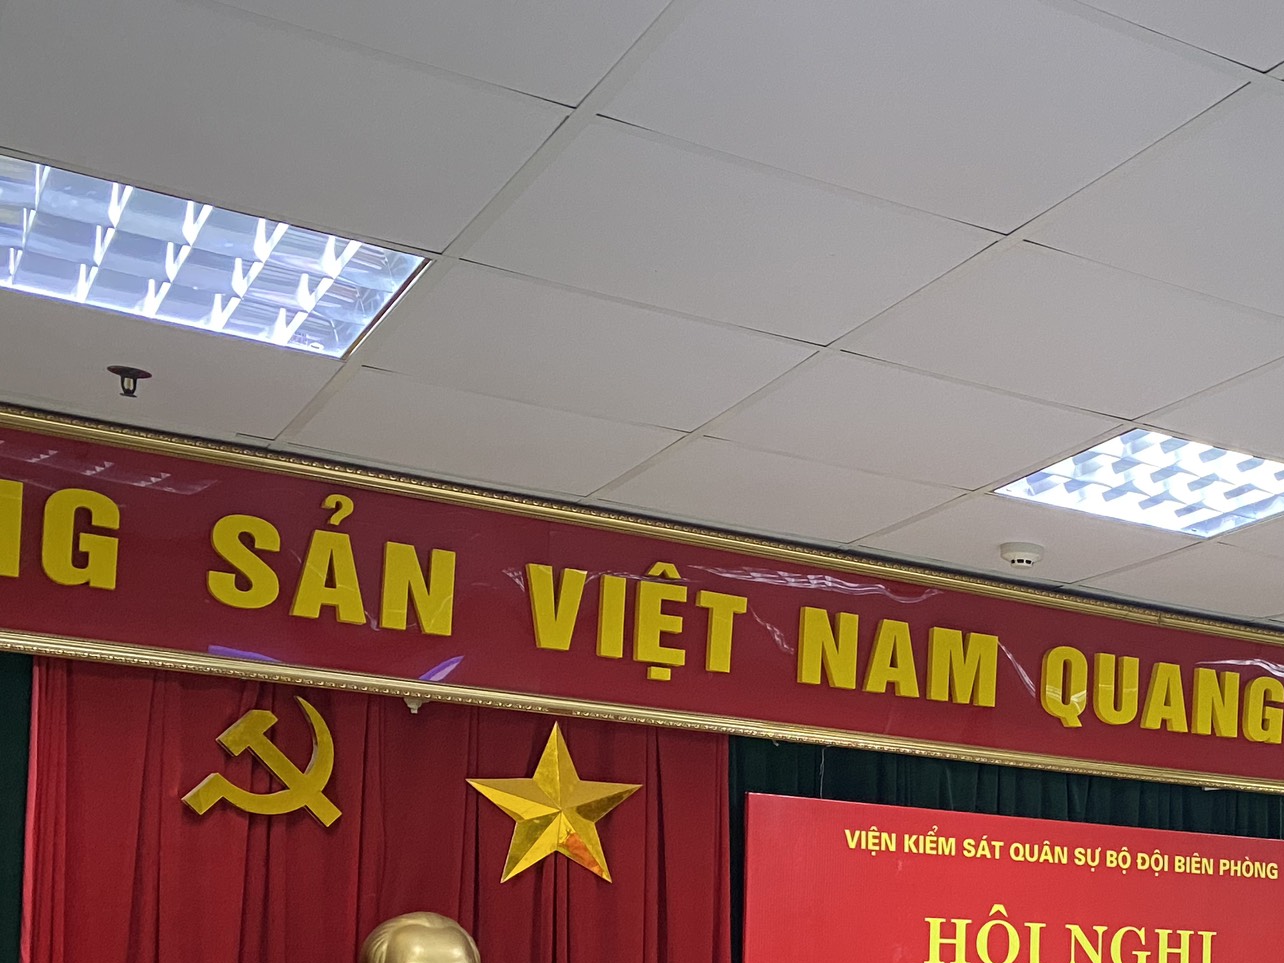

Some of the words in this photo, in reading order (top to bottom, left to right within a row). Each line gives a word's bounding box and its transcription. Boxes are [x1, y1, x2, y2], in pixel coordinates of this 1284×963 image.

[206, 494, 457, 637] SẢN
[527, 563, 748, 682] VIỆT
[797, 606, 1000, 708] NAM
[844, 826, 897, 856] VIỆN
[903, 825, 957, 858] KIỂM
[962, 834, 1004, 860] SÁT
[1010, 838, 1068, 865] QUÂN
[1074, 843, 1101, 874] SỰ
[1106, 846, 1132, 875] BỘ
[1136, 848, 1171, 878] ĐỘI
[1174, 850, 1214, 876] BIÊN
[1219, 857, 1279, 881] PHÒNG
